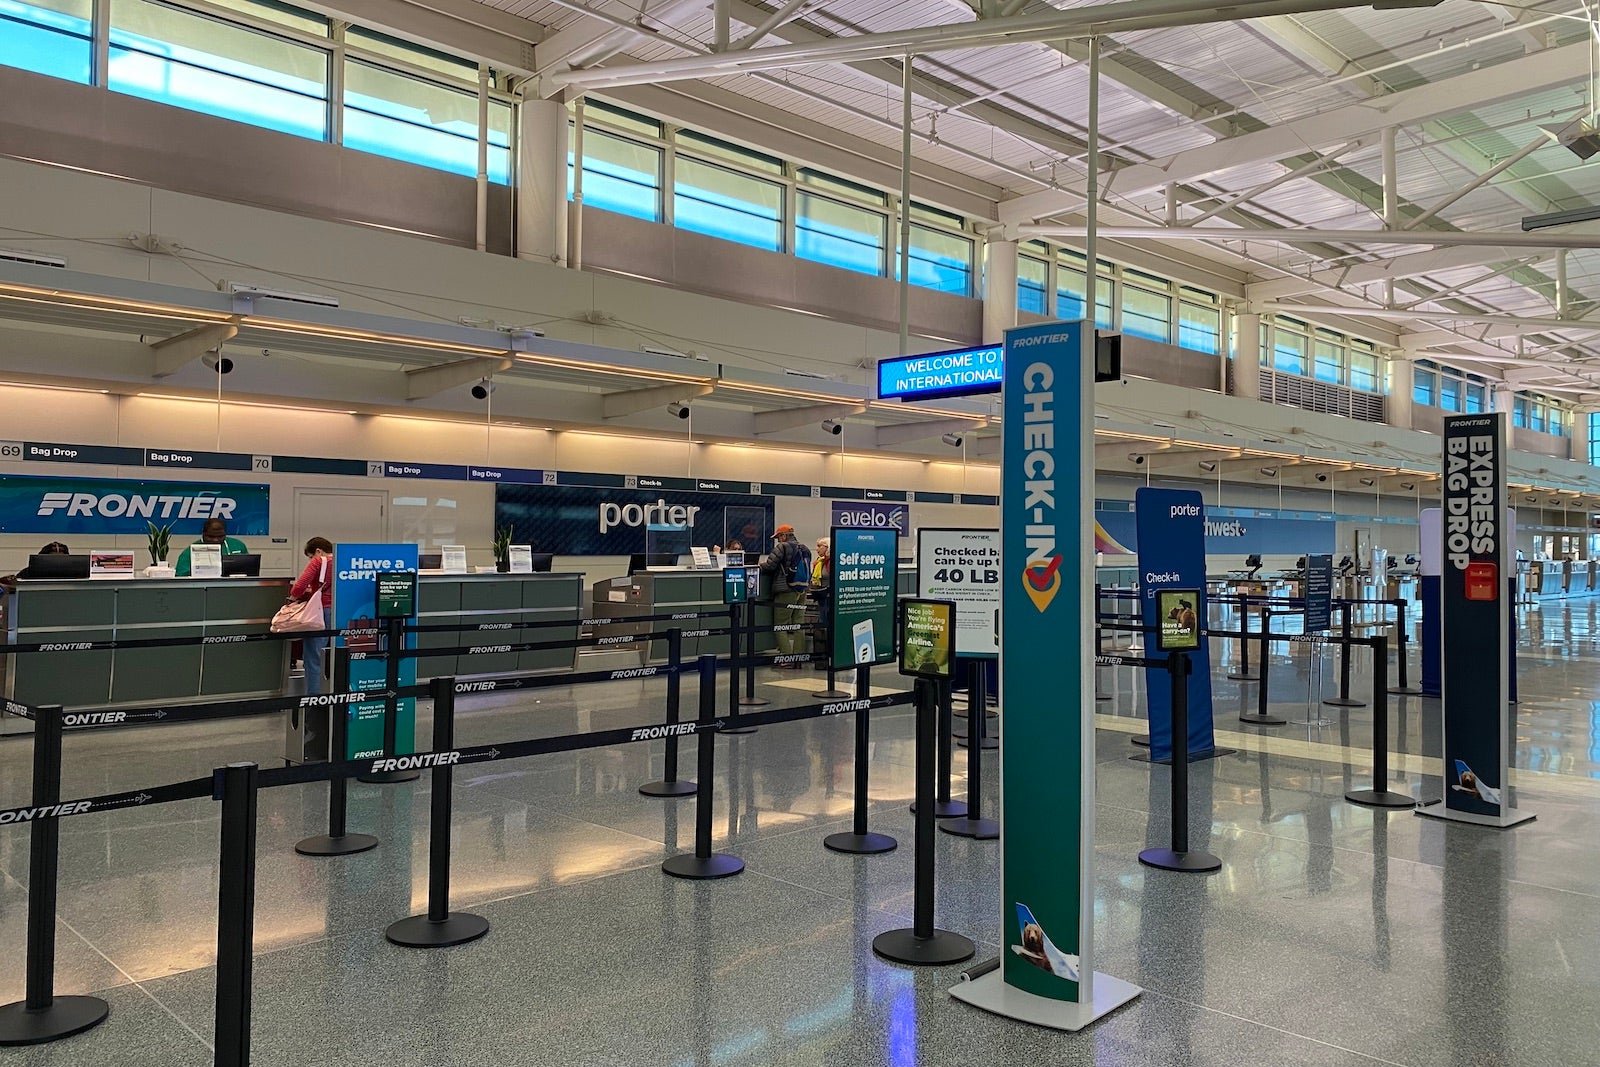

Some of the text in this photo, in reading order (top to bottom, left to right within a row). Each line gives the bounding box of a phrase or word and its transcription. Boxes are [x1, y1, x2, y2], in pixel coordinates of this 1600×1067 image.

[1013, 333, 1069, 348] FRONTIER
[905, 353, 973, 374] WELCOME
[976, 350, 997, 364] TO
[896, 367, 1003, 391] INTERNATIONAL
[1450, 418, 1491, 428] FRONTIER
[1, 445, 20, 456] 69
[31, 446, 78, 458] Bag Drop
[151, 453, 193, 463] Bag Drop
[255, 459, 269, 468] 70
[370, 464, 382, 474] 71
[388, 465, 421, 475] Bag Drop
[1023, 361, 1056, 568] CHECK-IN
[472, 470, 502, 479] Bag Drop
[544, 473, 555, 482] 72
[627, 478, 636, 486] 73
[752, 485, 760, 493] 74
[1469, 435, 1495, 554] EXPRESS
[37, 491, 237, 519] FRONTIER
[1448, 436, 1470, 570] BAG DROP
[600, 499, 700, 534] porter
[840, 508, 886, 526] avelo
[1170, 504, 1200, 519] porter
[1203, 516, 1241, 537] hwest
[934, 547, 986, 556] Checked
[351, 557, 405, 569] Have a
[839, 553, 885, 566] Self serve
[958, 557, 974, 566] be
[977, 558, 993, 568] up
[839, 567, 883, 581] and save!
[933, 569, 999, 584] 40 LB
[1145, 572, 1180, 583] Check-in
[922, 608, 935, 616] job!
[907, 614, 945, 625] You're flying
[340, 628, 378, 636] FRONTIER
[907, 621, 944, 632] America's
[1162, 627, 1191, 635] carry-on?
[202, 635, 247, 644] FRONTIER
[598, 636, 634, 645] FRONTIER
[907, 637, 934, 647] Airline.
[39, 642, 93, 651] FRONTIER
[469, 645, 512, 654] FRONTIER
[773, 654, 811, 663] FRONTIER
[611, 667, 657, 679] FRONTIER
[455, 681, 496, 693] ONTIER
[299, 693, 366, 707] FRONTIER
[5, 701, 28, 717] FRONTIER
[822, 700, 871, 715] FRONTIER
[61, 711, 127, 725] ONTIER
[631, 723, 696, 740] FRONTIER
[354, 749, 384, 759] FRONTI
[370, 751, 460, 773] FRONTIER
[0, 801, 92, 824] ONTIER
